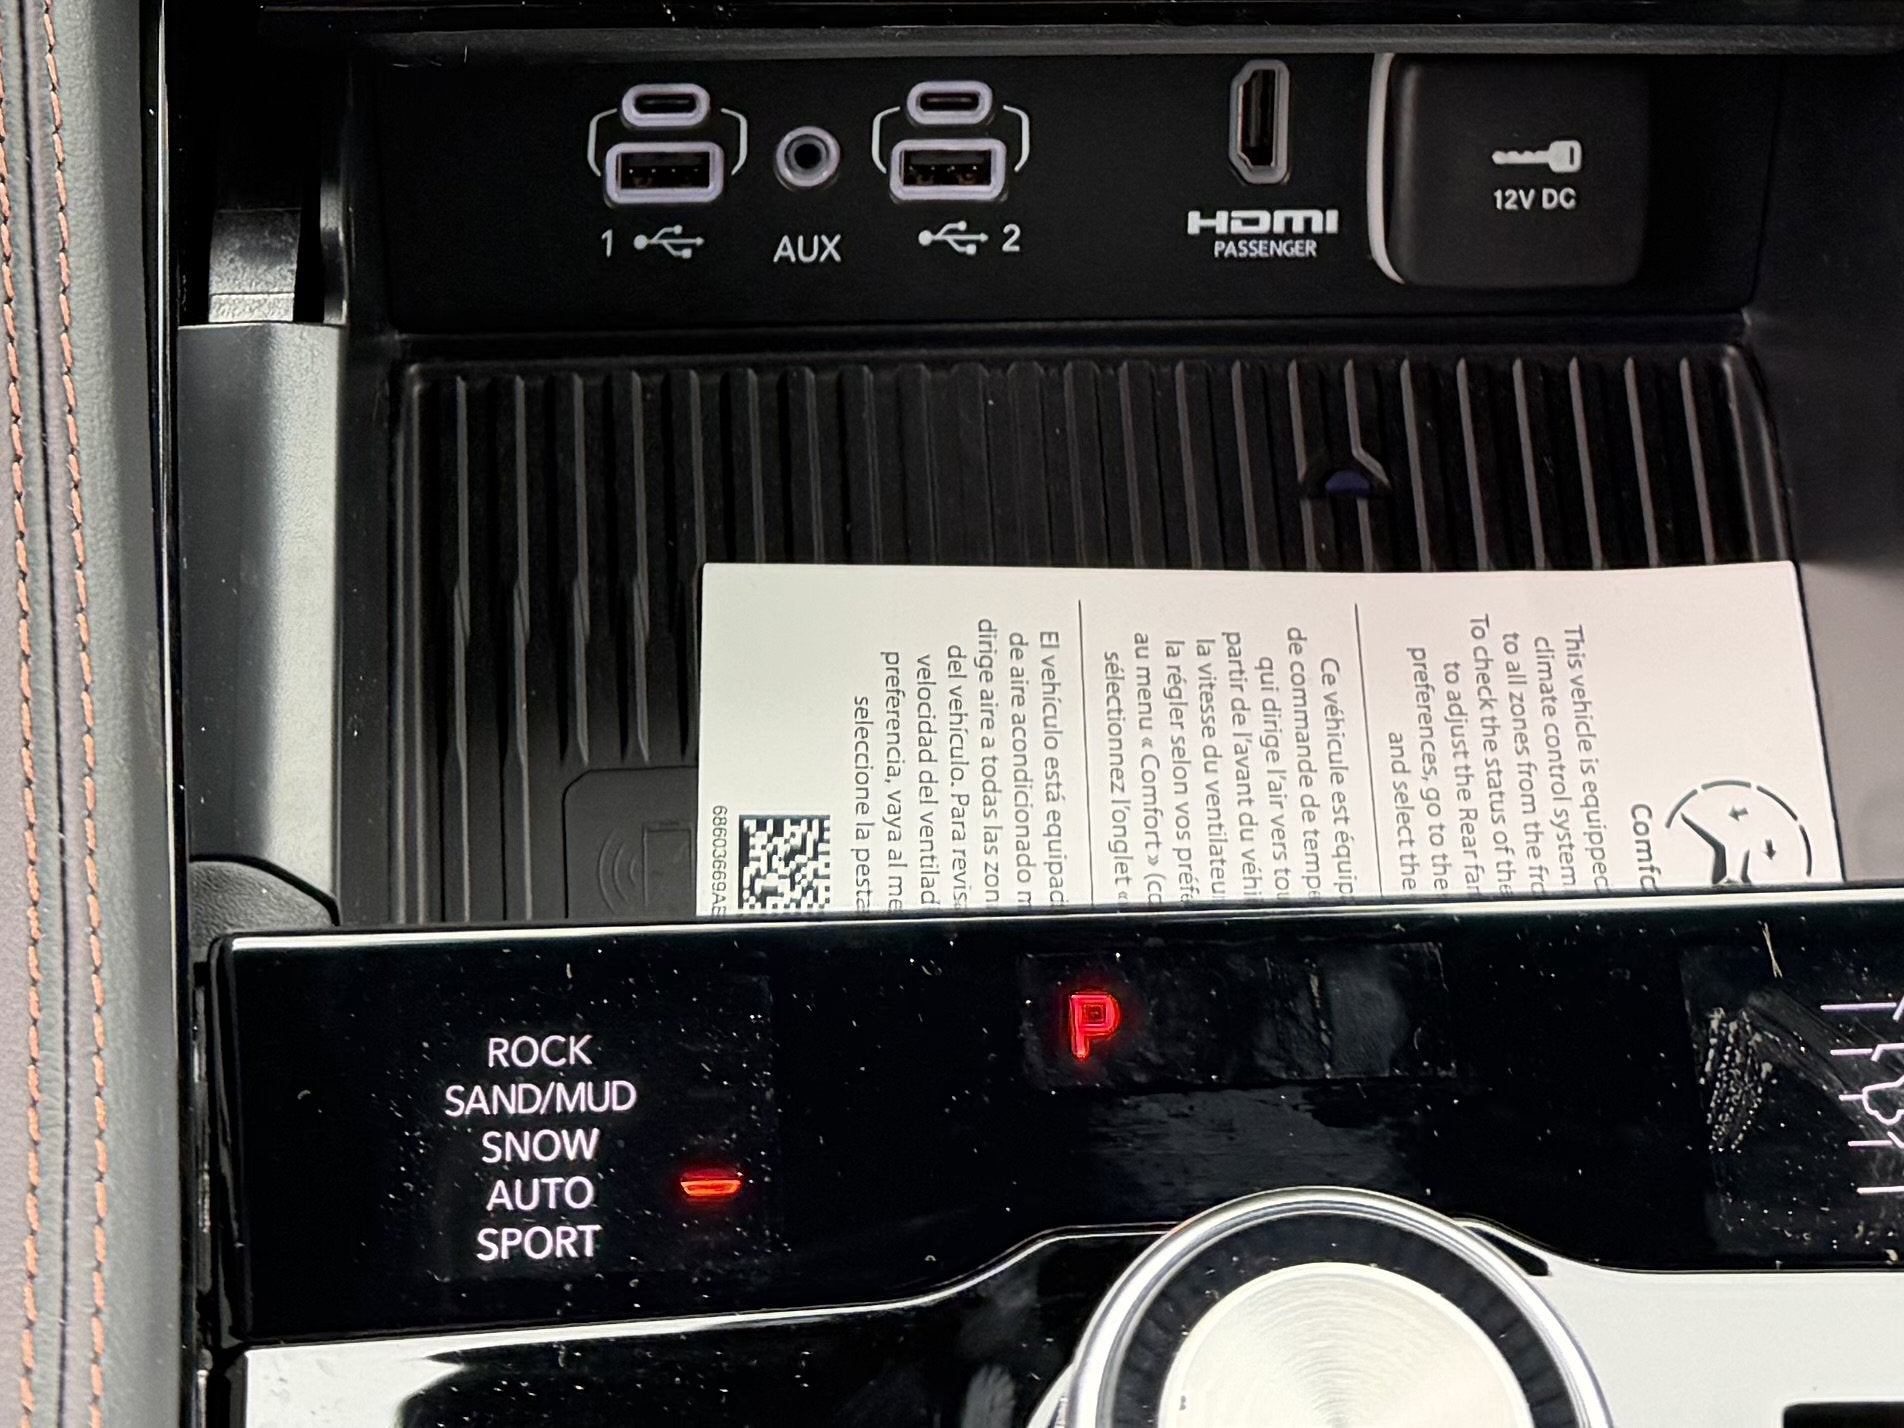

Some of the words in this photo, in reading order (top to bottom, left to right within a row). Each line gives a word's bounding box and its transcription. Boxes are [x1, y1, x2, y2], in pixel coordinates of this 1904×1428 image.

[1494, 188, 1536, 210] 12V
[1542, 187, 1576, 209] DC
[1002, 224, 1021, 252] 2
[1187, 209, 1338, 234] HDMI
[602, 230, 614, 257] 1
[774, 234, 842, 263] AUX
[1214, 239, 1317, 258] PASSENGER
[1040, 631, 1059, 649] El
[1288, 628, 1307, 656] de
[1470, 614, 1490, 639] To
[1502, 633, 1520, 655] to
[947, 645, 968, 679] del
[974, 619, 998, 683] dirige
[1009, 632, 1029, 661] de
[1134, 633, 1150, 659] au
[1165, 641, 1184, 657] la
[1196, 639, 1215, 656] la
[1222, 632, 1247, 692] partir
[1565, 625, 1586, 669] This
[1010, 667, 1028, 707] aire
[1255, 657, 1279, 691] qui
[1321, 658, 1340, 686] Ce
[1443, 662, 1461, 683] to
[1472, 646, 1496, 710] check
[1506, 660, 1528, 685] all
[1534, 636, 1557, 717] climate
[917, 655, 938, 763] velocidad
[980, 689, 999, 730] aire
[1042, 655, 1063, 750] vehículo
[1136, 666, 1154, 730] menu
[1163, 665, 1188, 729] régler
[1198, 663, 1217, 738] vitesse
[1231, 698, 1250, 726] de
[1407, 647, 1438, 781] preferences,
[1569, 675, 1597, 752] vehicle
[881, 651, 905, 783] preferencia,
[1104, 652, 1127, 792] sélectionnez
[1258, 698, 1283, 763] dirige
[1290, 661, 1318, 788] commande
[1444, 690, 1472, 759] adjust
[1479, 716, 1500, 752] the
[1508, 692, 1532, 756] zones
[854, 696, 873, 815] seleccione
[949, 686, 969, 787] vehículo.
[982, 736, 994, 749] a
[1323, 691, 1348, 784] véhicule
[1388, 732, 1411, 775] and
[1171, 736, 1191, 795] selon
[1202, 745, 1222, 774] du
[1543, 723, 1572, 802] control
[1579, 759, 1600, 775] is
[919, 770, 939, 804] del
[982, 756, 1003, 819] todas
[1011, 714, 1035, 882] acondicionado
[1045, 757, 1066, 803] está
[1454, 764, 1475, 802] the
[1483, 757, 1507, 825] status
[1515, 762, 1538, 816] from
[882, 790, 904, 842] vaya
[951, 794, 969, 841] Para
[1141, 755, 1163, 849] Comfort
[1175, 802, 1190, 840] vos
[1302, 795, 1321, 823] de
[1333, 791, 1350, 824] est
[1392, 781, 1416, 847] select
[1418, 788, 1441, 817] go
[855, 822, 874, 840] la
[983, 825, 1003, 855] las
[1205, 781, 1226, 899] ventilateu
[1240, 812, 1259, 841] du
[1271, 814, 1287, 860] vers
[1427, 823, 1446, 847] to
[1458, 808, 1479, 858] Rear
[1492, 831, 1513, 855] of
[1524, 822, 1545, 860] the
[888, 849, 907, 868] al
[1334, 831, 1357, 897] équip
[1552, 808, 1577, 886] system
[1399, 853, 1419, 890] the
[1431, 854, 1451, 890] the
[1069, 991, 1121, 1059] P
[488, 1034, 593, 1068] ROCK
[445, 1080, 637, 1117] SAND/MUD
[481, 1127, 600, 1164] SNOW
[486, 1177, 594, 1211] AUTO
[476, 1225, 601, 1261] SPORT
